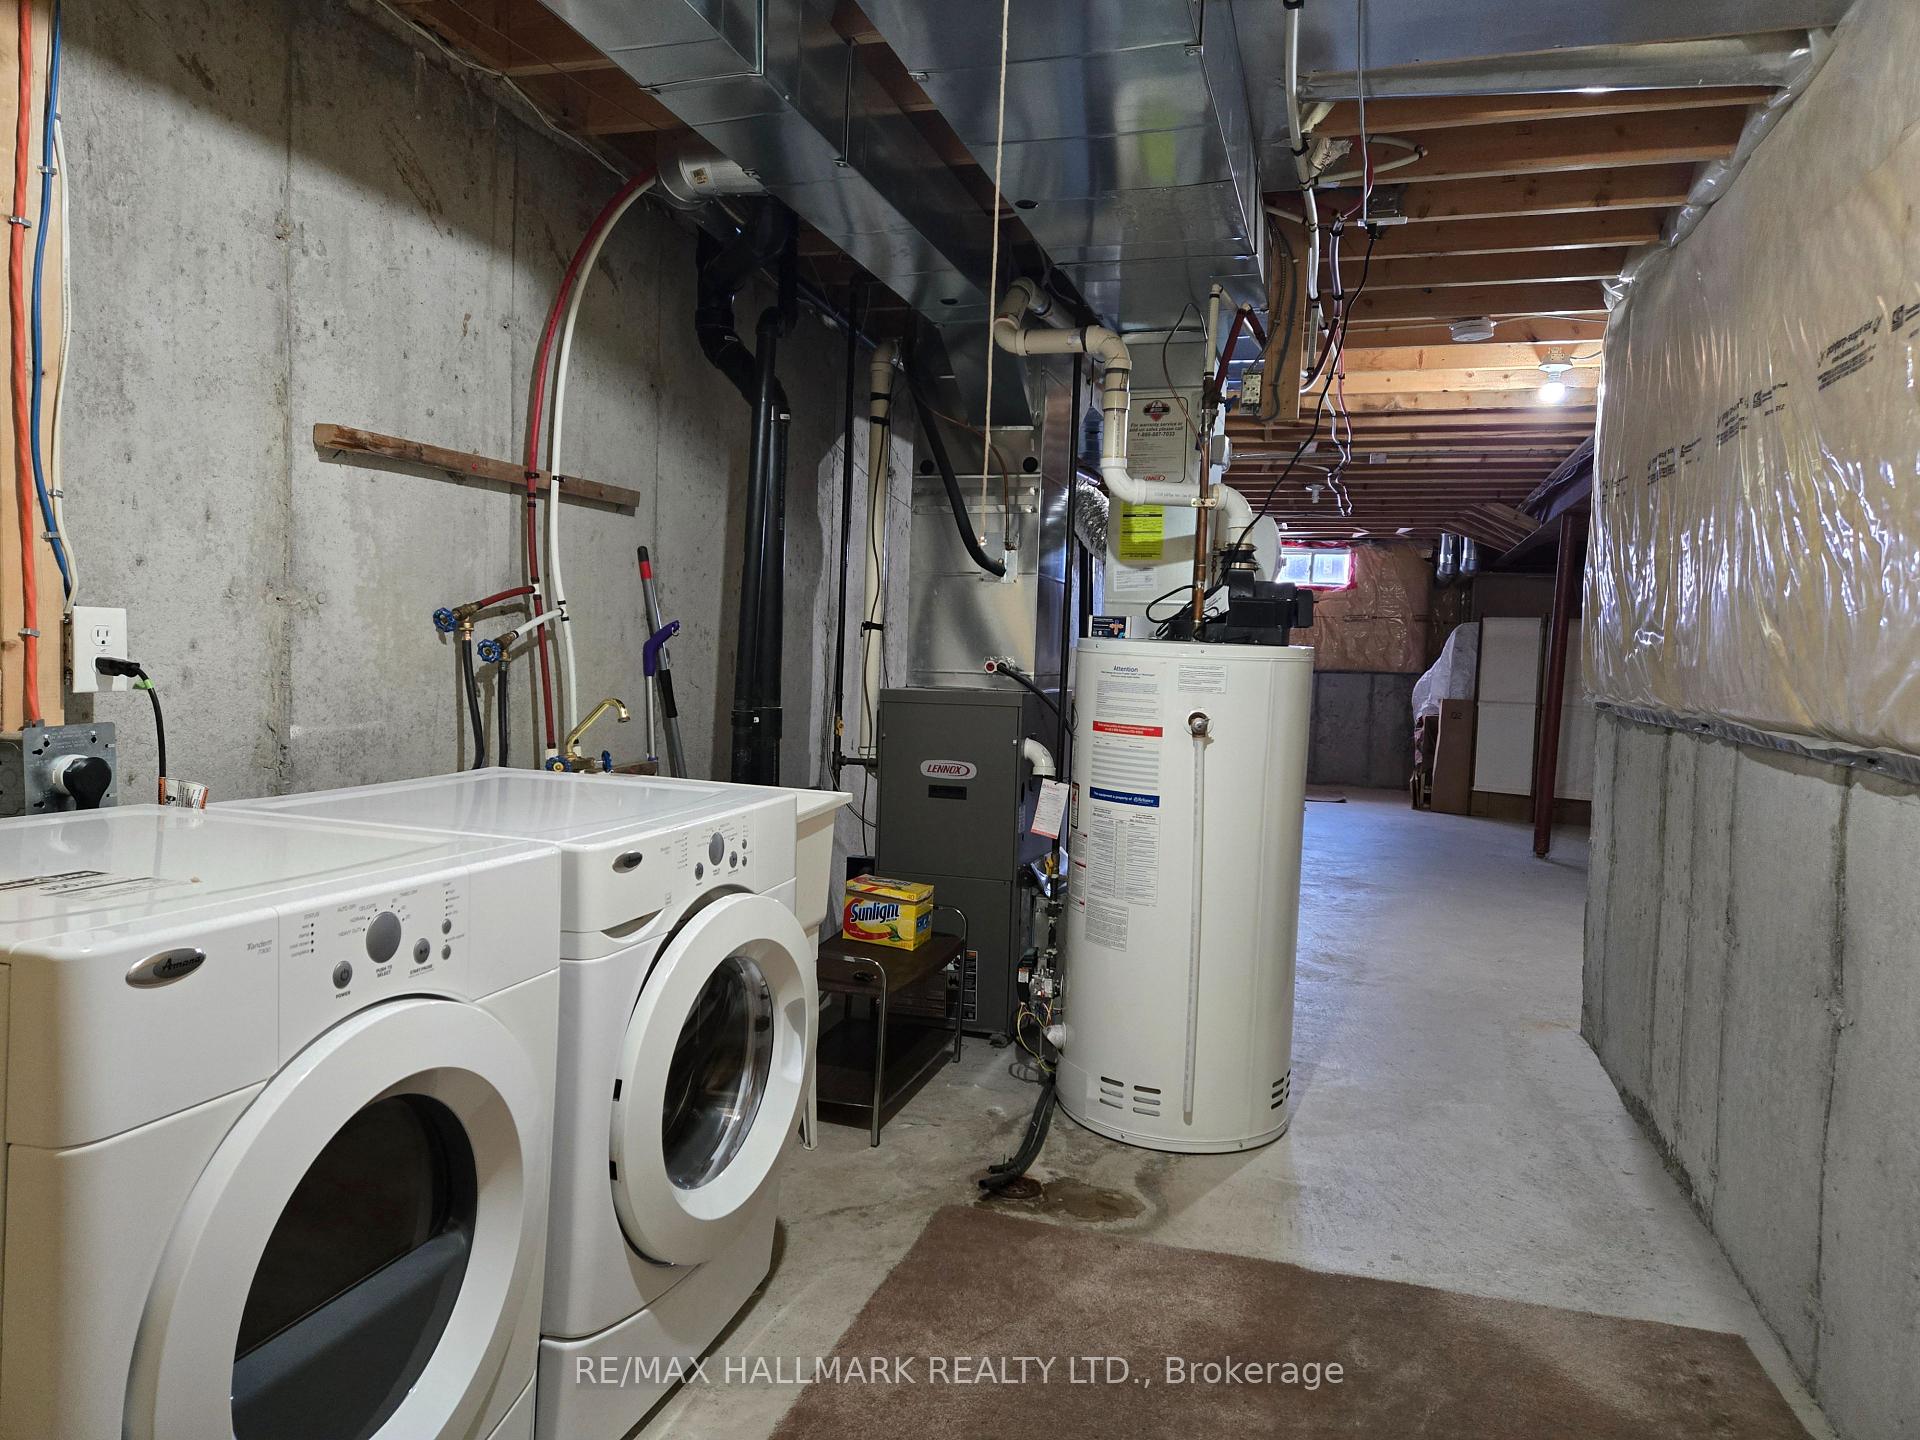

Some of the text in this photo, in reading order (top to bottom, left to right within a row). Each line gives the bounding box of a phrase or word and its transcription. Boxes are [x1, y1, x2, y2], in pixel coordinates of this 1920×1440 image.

[1113, 665, 1139, 673] Attention
[927, 764, 961, 774] LENNOX
[162, 957, 204, 971] Amana
[335, 990, 351, 999] POWER
